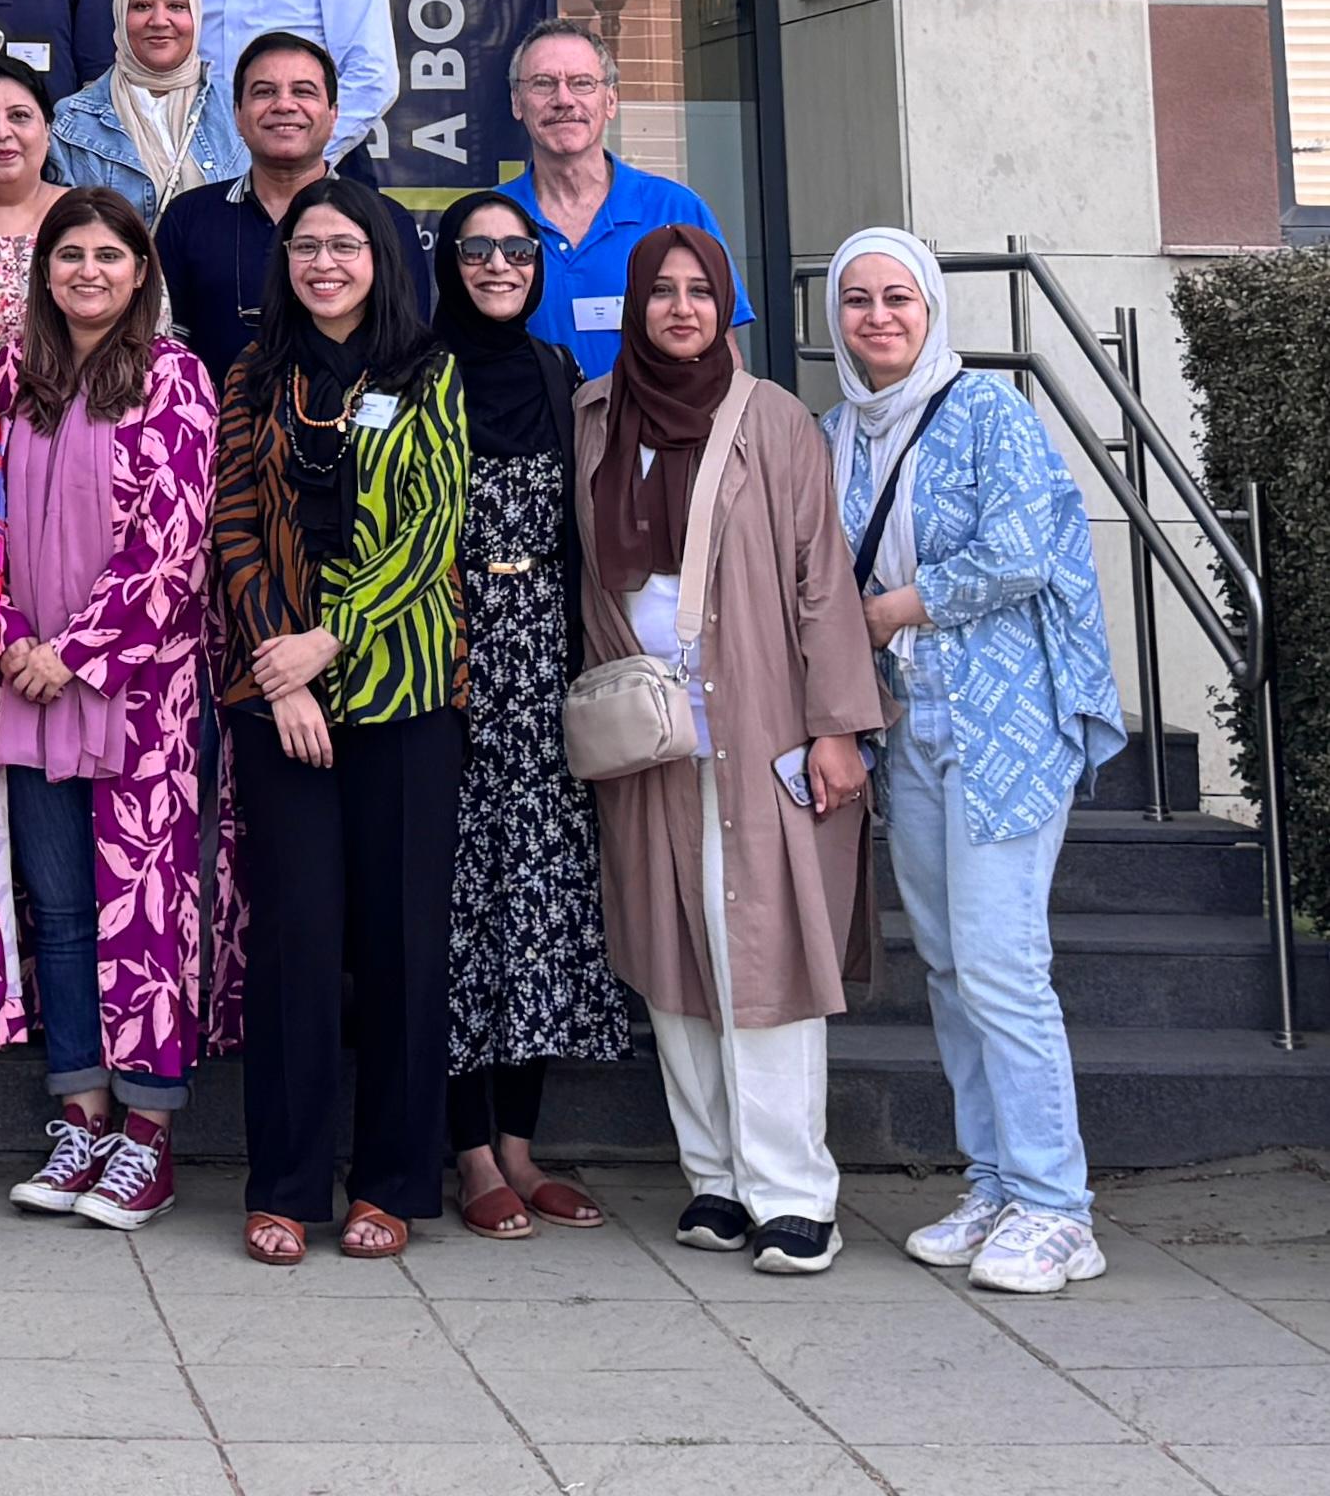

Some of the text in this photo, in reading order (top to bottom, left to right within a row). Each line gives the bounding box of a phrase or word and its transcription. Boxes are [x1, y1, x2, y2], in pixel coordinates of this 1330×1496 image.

[412, 112, 468, 165] A
[995, 616, 1038, 650] TOMMY
[980, 644, 1020, 675] JEANS
[981, 679, 1010, 717] JEANS
[998, 722, 1039, 755] JEANS
[966, 736, 1001, 781] TOMMY
[996, 760, 1026, 799] JEANS
